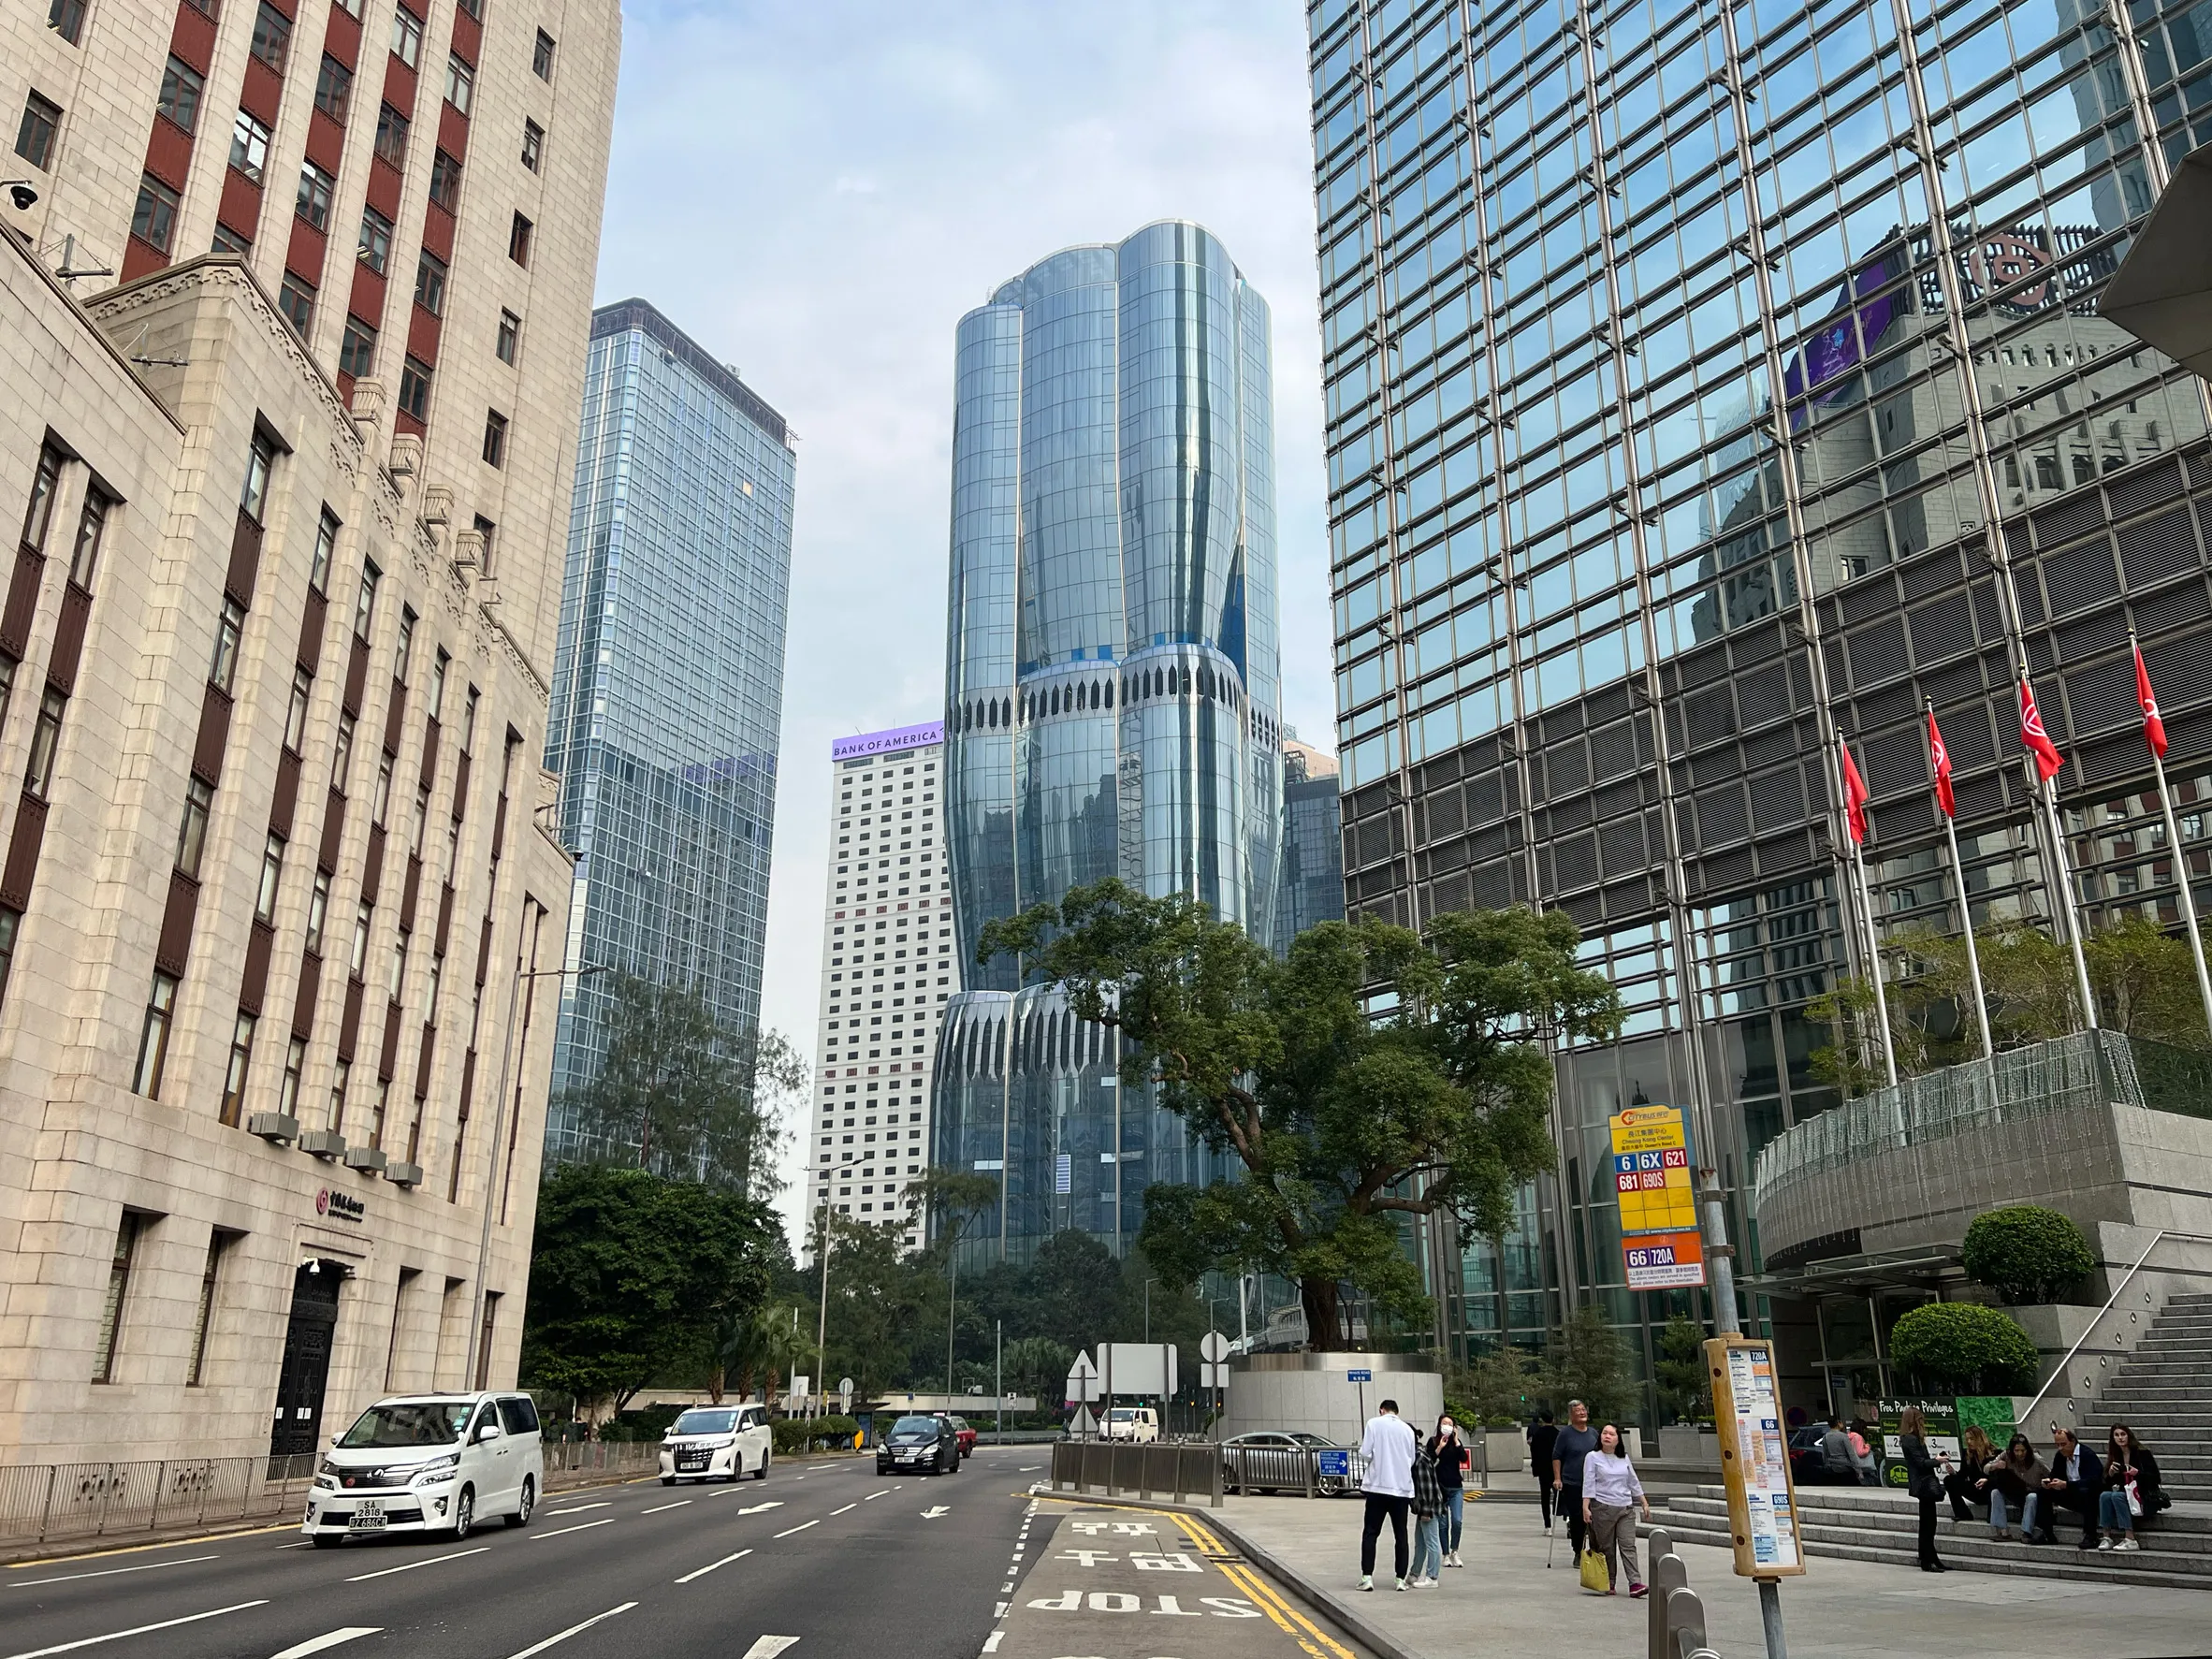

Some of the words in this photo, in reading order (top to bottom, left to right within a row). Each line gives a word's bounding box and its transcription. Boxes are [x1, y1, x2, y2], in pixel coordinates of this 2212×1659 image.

[834, 743, 865, 756] BANK
[867, 740, 882, 750] OF
[884, 731, 937, 748] AMERICA
[1628, 1113, 1656, 1122] CITYBUS
[1622, 1156, 1631, 1171] 6
[1640, 1152, 1661, 1169] 6X
[1666, 1150, 1685, 1167] 621
[1619, 1173, 1638, 1190] 681
[1642, 1171, 1664, 1188] 690S
[1629, 1250, 1648, 1266] 66
[1651, 1247, 1674, 1265] 720A
[1751, 1351, 1768, 1361] 720A
[1879, 1400, 1894, 1412] Free
[1921, 1400, 1954, 1417] Privileges
[1765, 1419, 1775, 1429] 66
[1931, 1438, 1938, 1448] 3
[1054, 1550, 1204, 1573] 巴士
[1026, 1591, 1263, 1618] STOP
